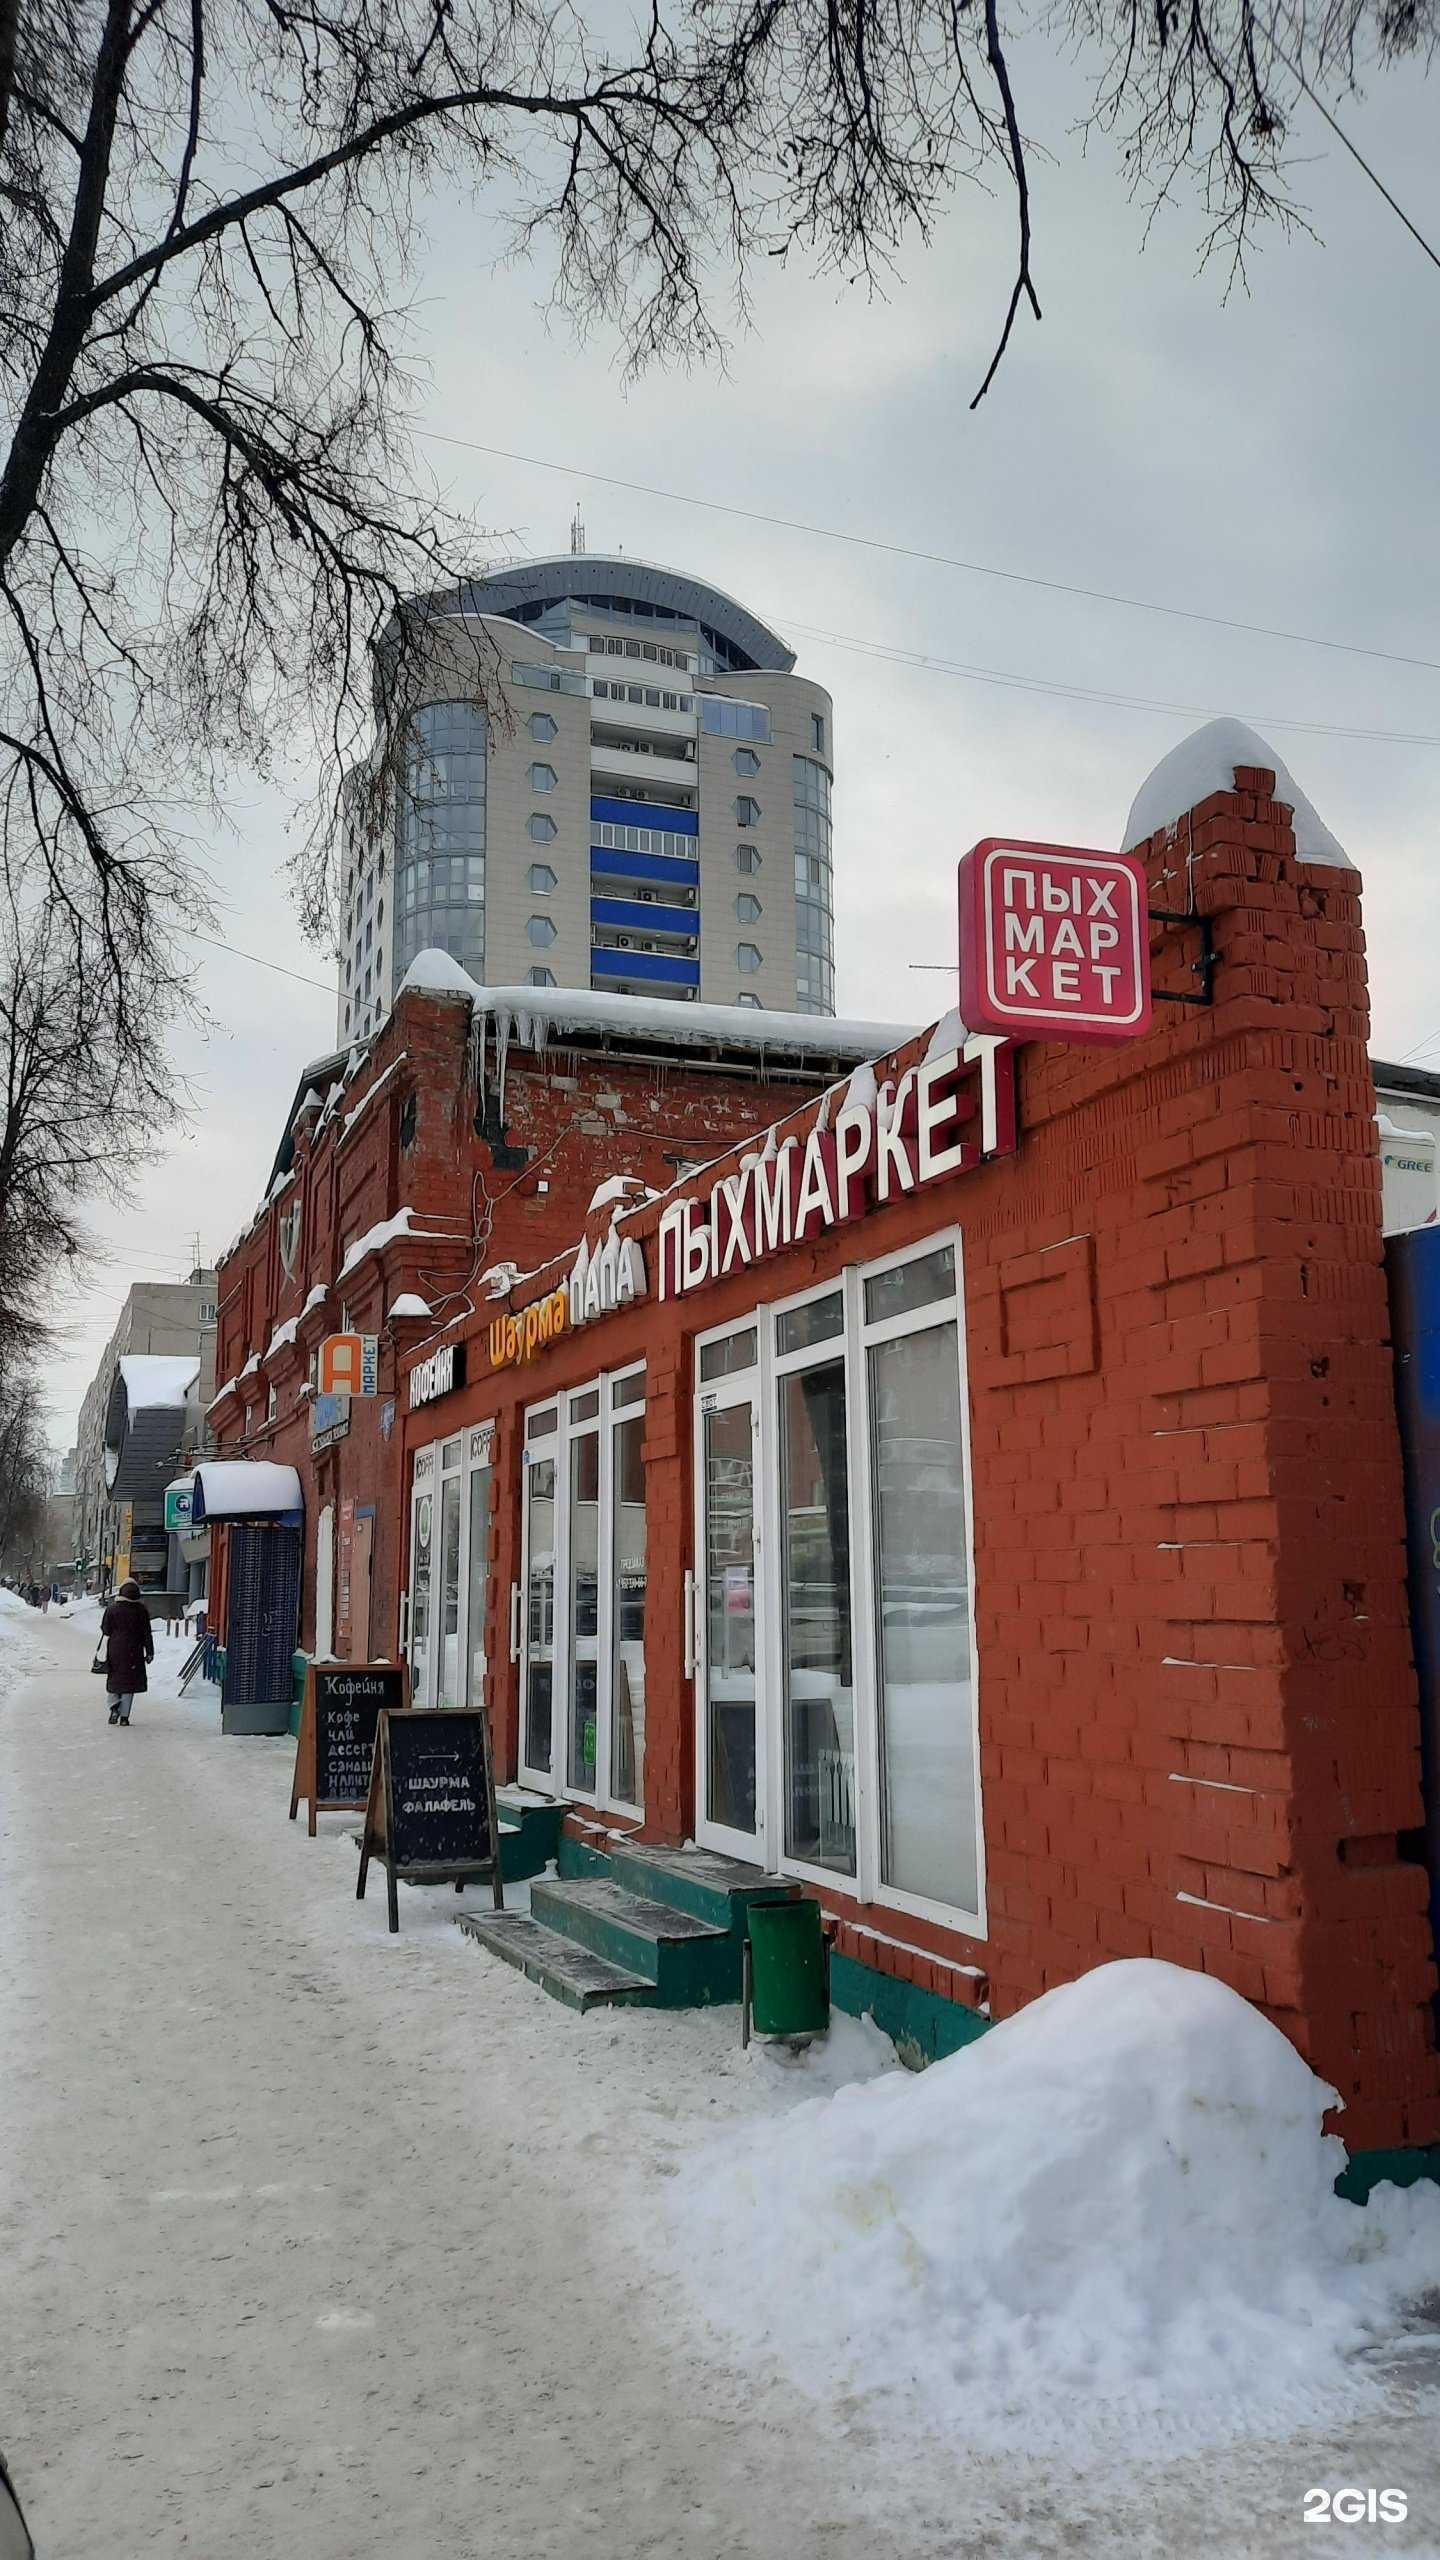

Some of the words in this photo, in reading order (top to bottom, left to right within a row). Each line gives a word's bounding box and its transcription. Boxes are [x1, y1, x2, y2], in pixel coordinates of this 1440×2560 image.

[1003, 868, 1119, 918] ПЫХ
[1004, 912, 1120, 960] МАР
[1006, 956, 1121, 1004] КЕТ
[659, 1034, 1009, 1302] ПЫХМАРКЕТ
[1397, 1159, 1433, 1172] GREE
[569, 1240, 636, 1326] ПАПА
[363, 1337, 376, 1394] МАРКЕТ
[324, 1676, 384, 1706] Кофейня
[327, 1710, 360, 1728] Кофе
[402, 1798, 476, 1813] ФАЛАФЕЛЬ
[408, 1776, 470, 1790] ШАУРМА
